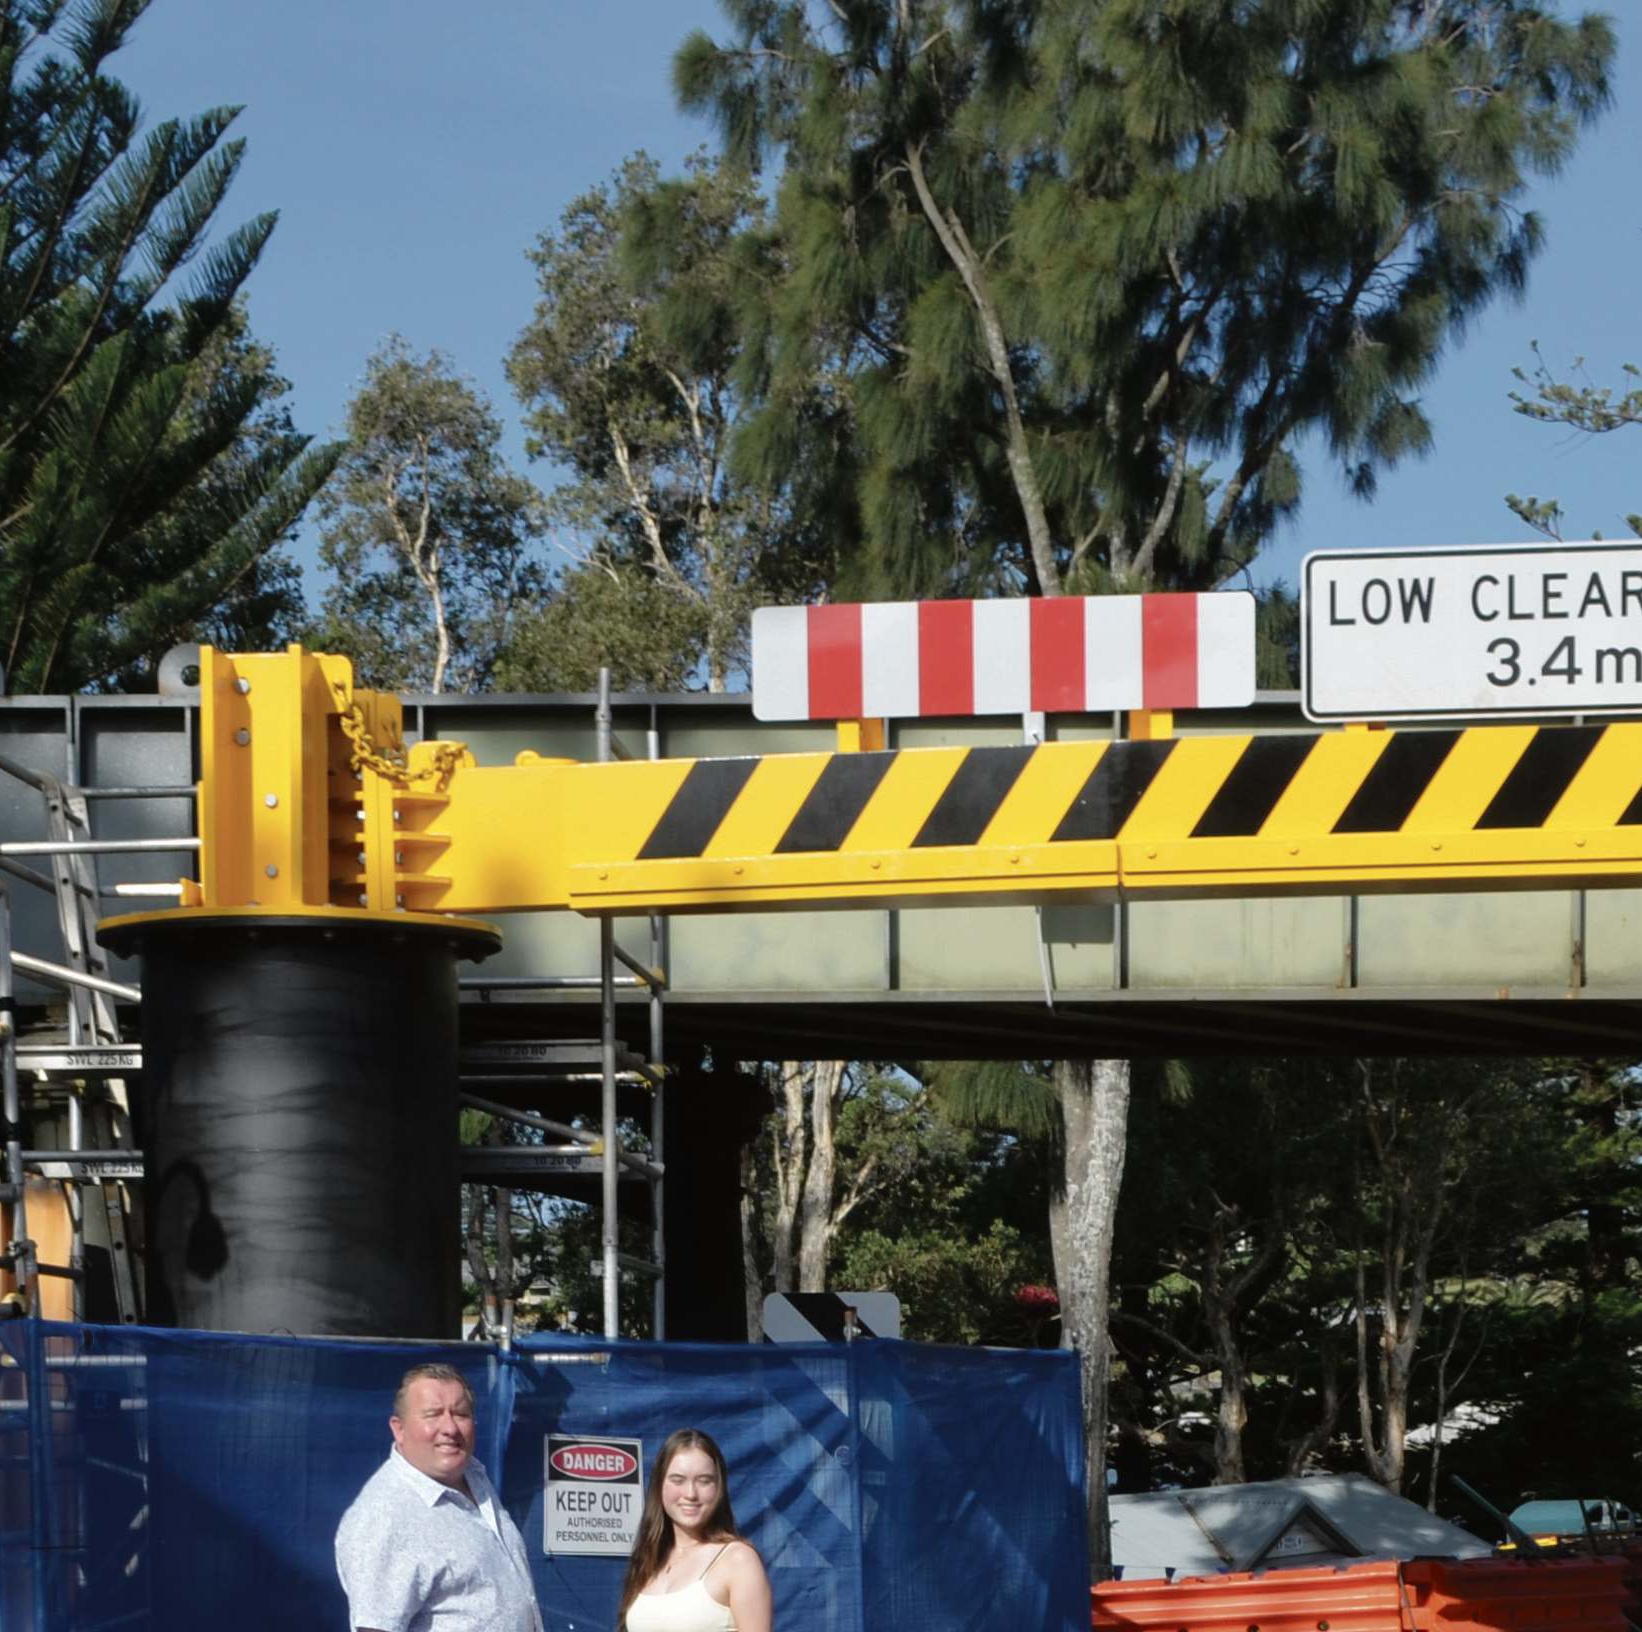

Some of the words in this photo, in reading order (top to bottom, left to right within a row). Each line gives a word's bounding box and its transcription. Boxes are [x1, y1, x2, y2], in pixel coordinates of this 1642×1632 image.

[1329, 576, 1436, 626] LOW
[562, 1452, 625, 1472] DANGER
[555, 1490, 597, 1512] KEEP
[601, 1492, 632, 1513] OUT
[567, 1517, 623, 1529] AUTHORISED
[556, 1531, 609, 1542] PERSONNEL
[612, 1532, 634, 1543] ONLY
